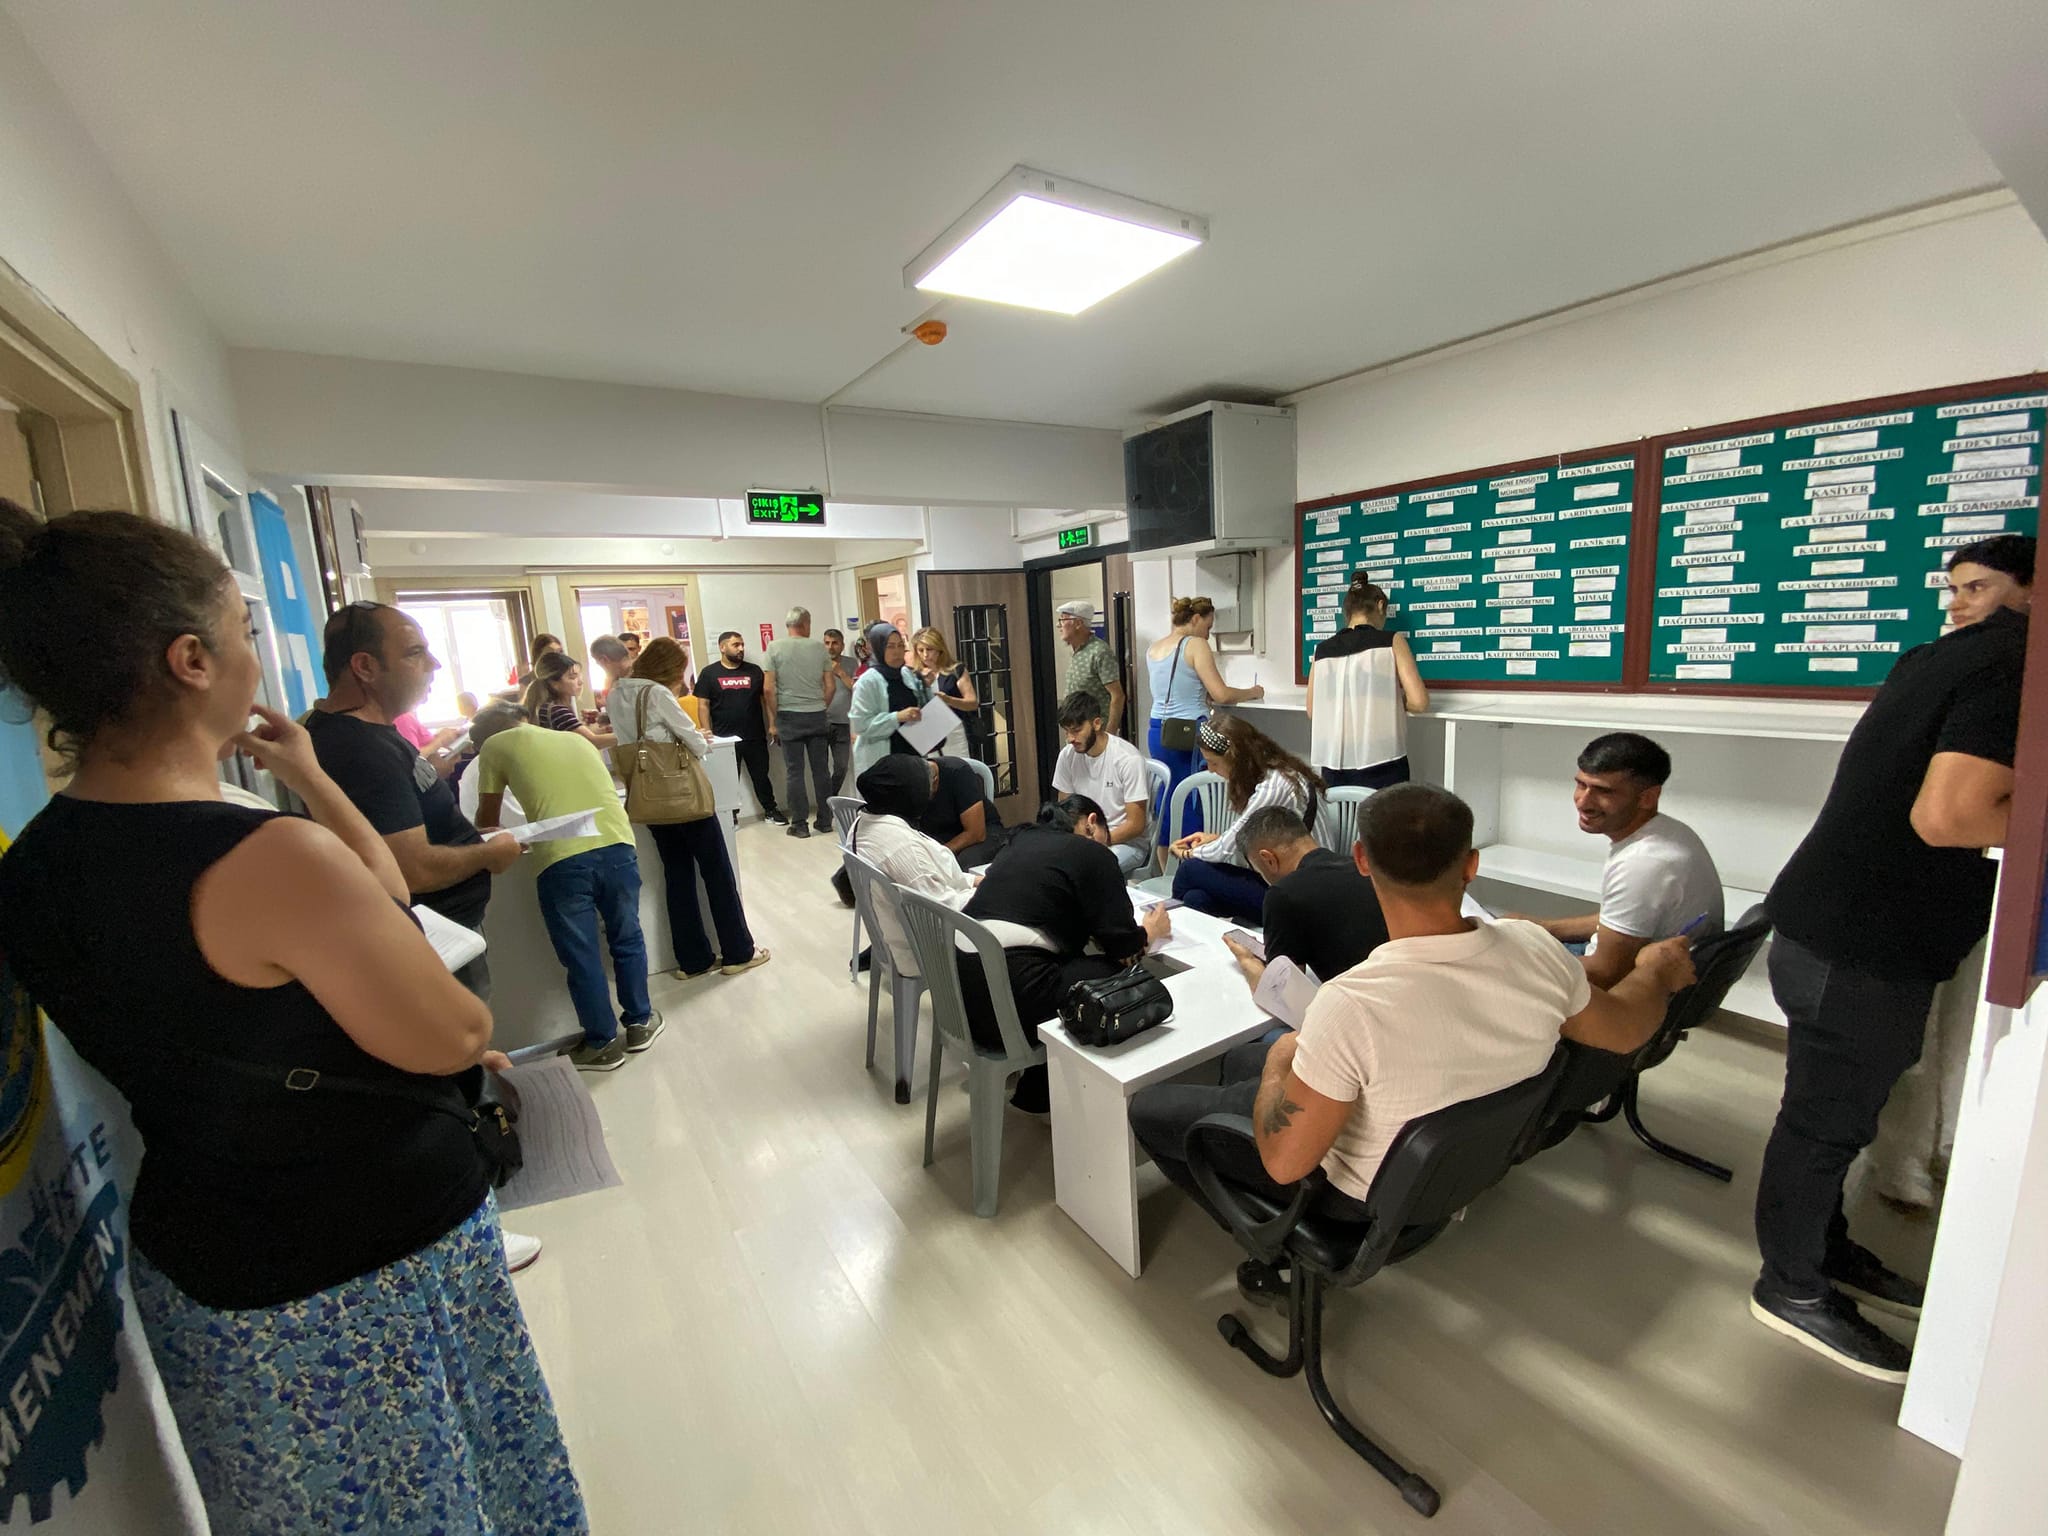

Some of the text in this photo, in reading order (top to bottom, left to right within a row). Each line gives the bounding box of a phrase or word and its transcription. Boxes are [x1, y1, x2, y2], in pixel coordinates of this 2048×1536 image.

[1942, 398, 2046, 417] MONTAJ USTASI
[1668, 442, 1724, 457] KAMYONET
[1948, 438, 1992, 450] BEDEN
[1784, 457, 1837, 470] TEMİZLİK
[1560, 461, 1633, 478] TEKNİK RESSAM
[1929, 473, 1963, 483] DEPO
[1810, 484, 1869, 498] KASİYER
[752, 498, 779, 509] ÇIKIŞ
[753, 510, 778, 518] EXIT
[1811, 516, 1826, 524] VE
[1830, 510, 1889, 522] TEMİZLİK
[1573, 539, 1604, 548] TEKNİK
[1798, 542, 1878, 555] KALIP USTASI
[1675, 553, 1741, 566] KAPORTACI
[1577, 593, 1609, 602] MİMAR
[1663, 615, 1761, 625] DAĞITIM ELEMANI
[1800, 610, 1872, 621] MAKİNELERİ
[1673, 645, 1705, 653] YEMEK
[1780, 643, 1894, 652] METAL KAPLAMACI
[1689, 653, 1733, 661] ELEMANI
